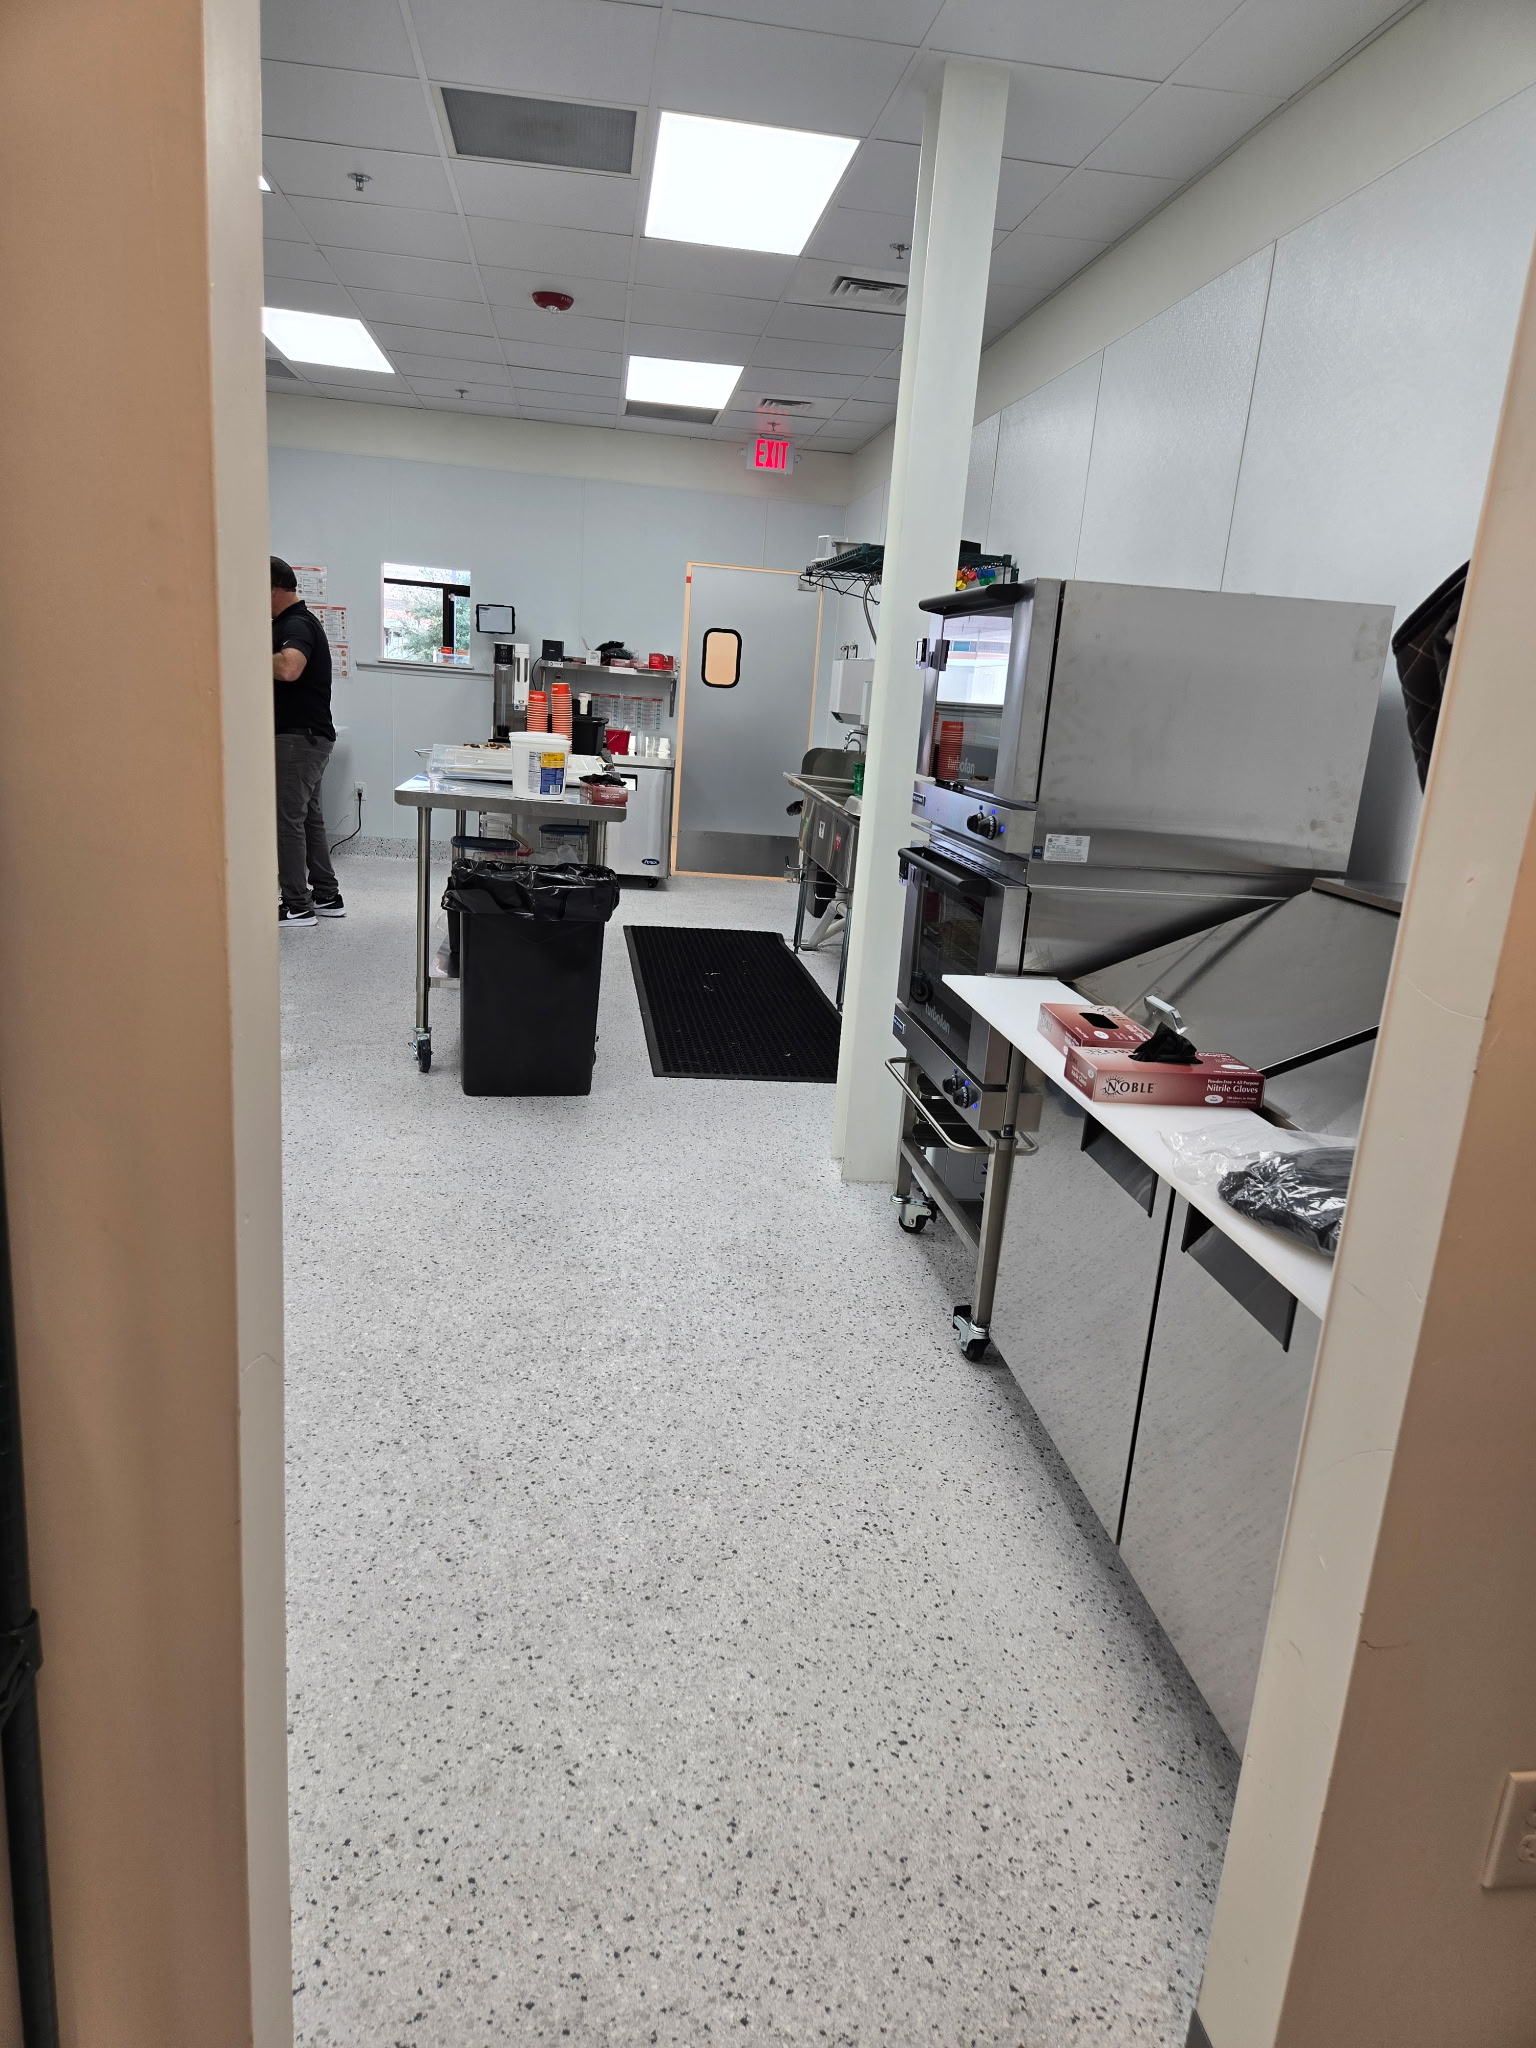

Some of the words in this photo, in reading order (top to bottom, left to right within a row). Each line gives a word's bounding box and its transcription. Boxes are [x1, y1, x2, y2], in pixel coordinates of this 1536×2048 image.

[755, 439, 789, 470] EXIT
[925, 1001, 950, 1034] turbofan
[1106, 1080, 1155, 1094] NOBLE
[1206, 1084, 1231, 1093] Nitrile
[1233, 1085, 1258, 1094] Gloves
